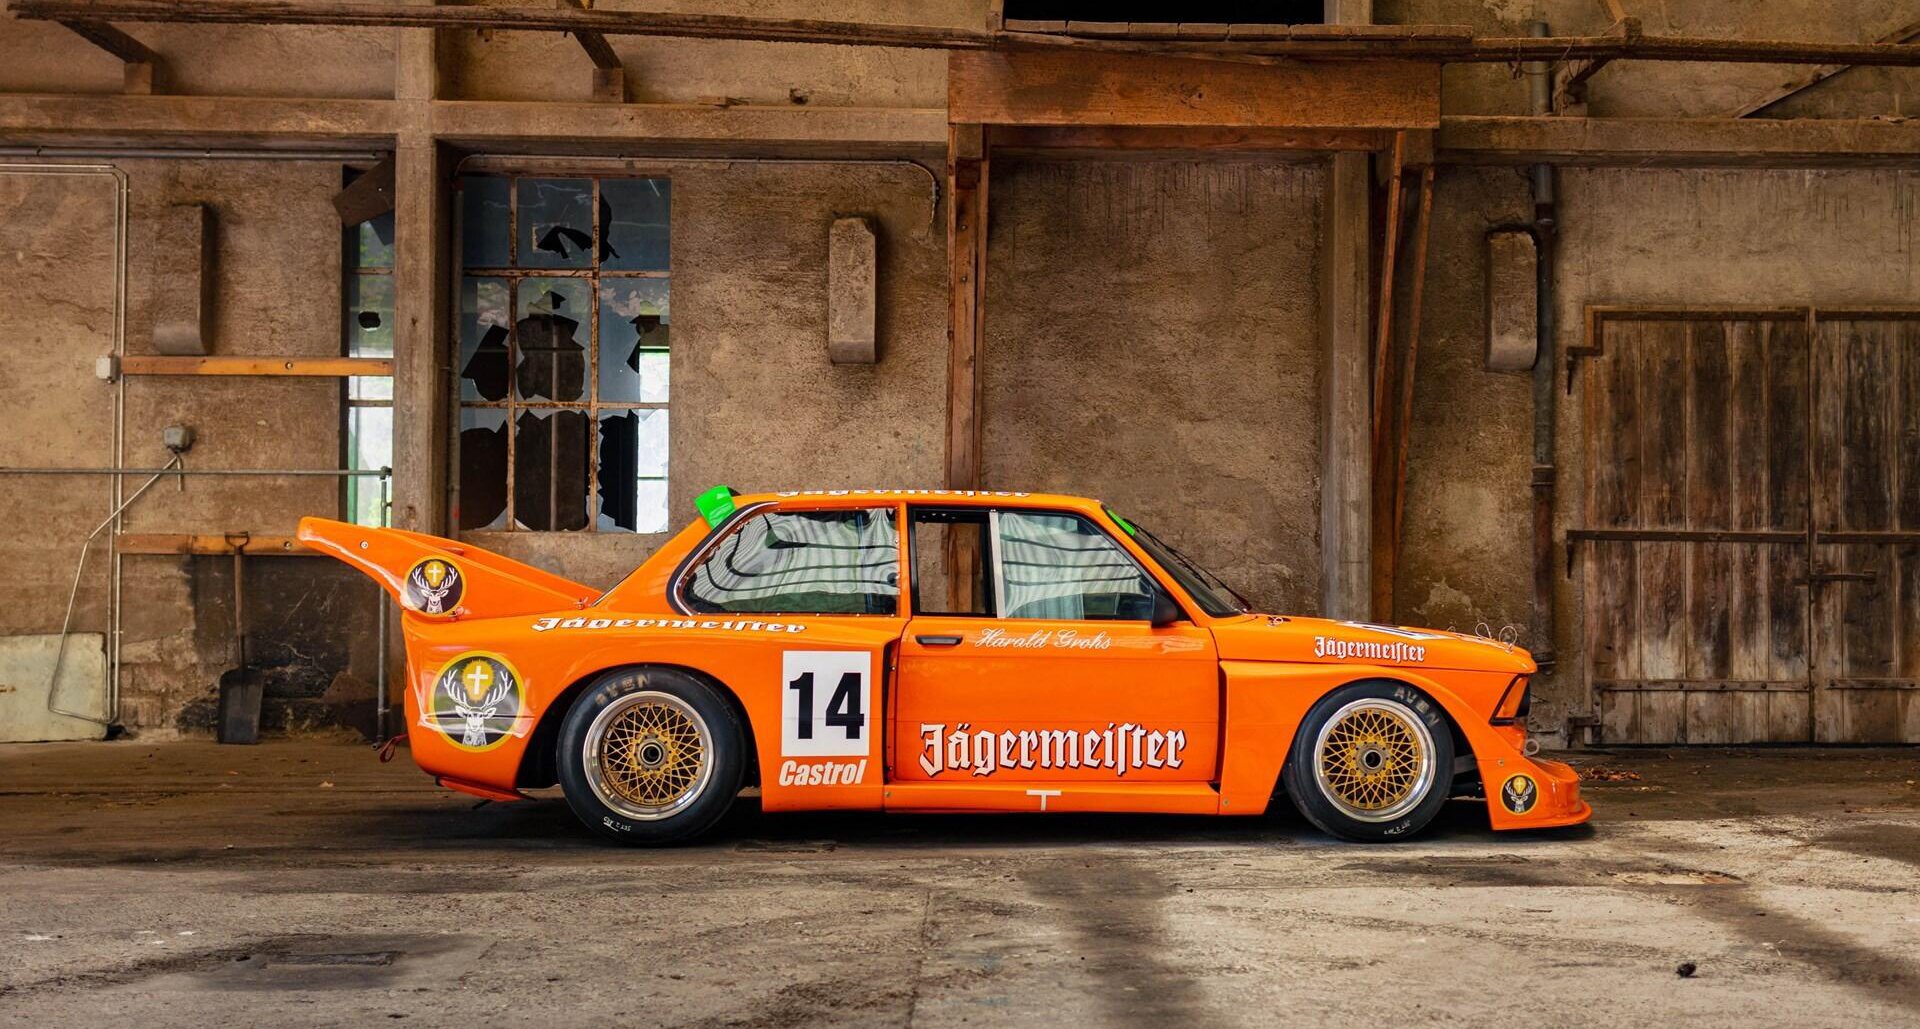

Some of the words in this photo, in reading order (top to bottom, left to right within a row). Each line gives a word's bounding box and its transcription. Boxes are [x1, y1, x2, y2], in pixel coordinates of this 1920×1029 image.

[976, 628, 1052, 649] Harald
[1054, 629, 1112, 650] Grohs
[789, 672, 864, 739] 14
[779, 759, 867, 786] Castrol
